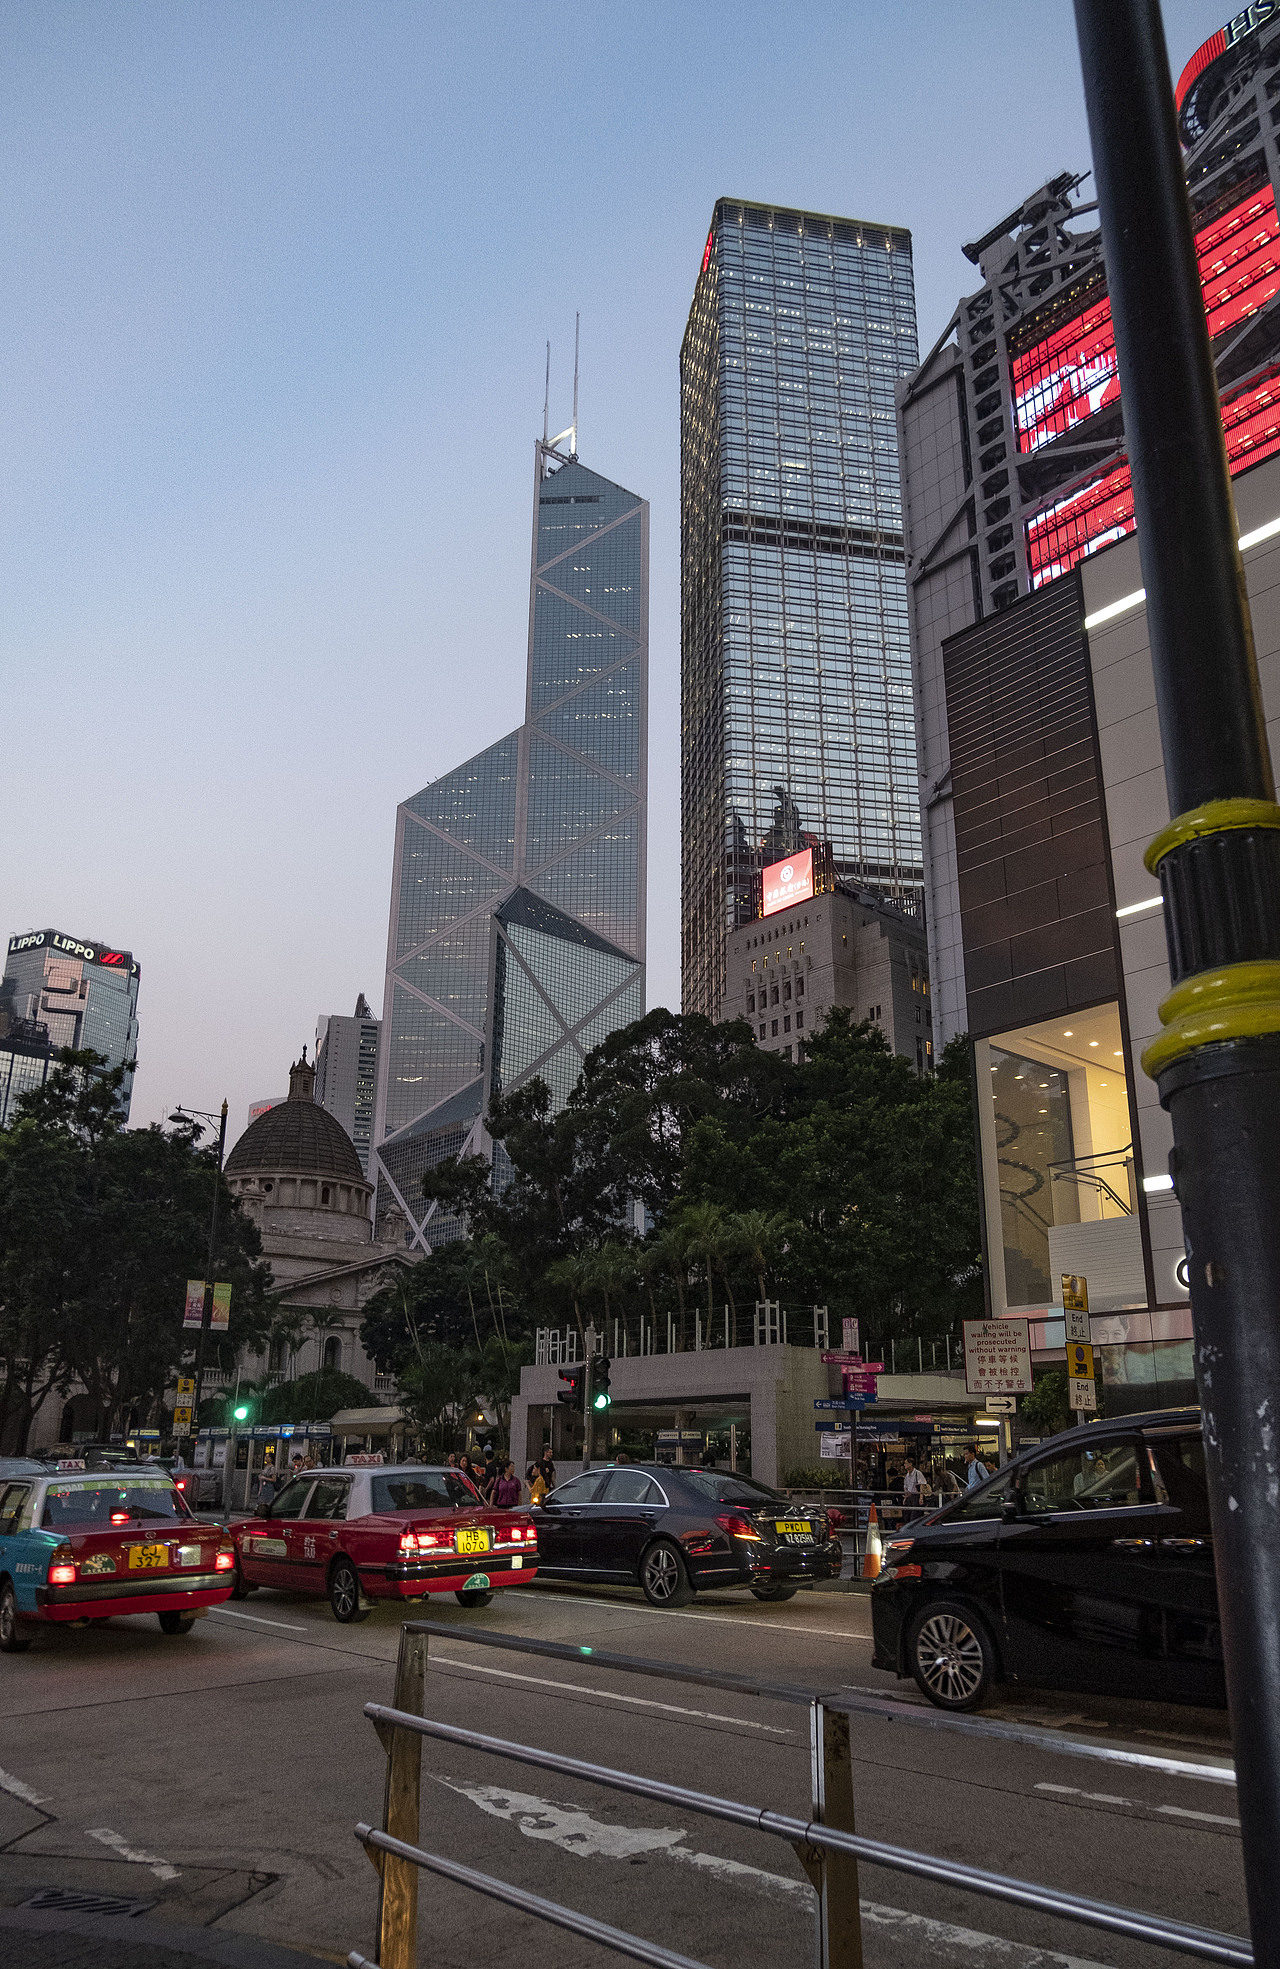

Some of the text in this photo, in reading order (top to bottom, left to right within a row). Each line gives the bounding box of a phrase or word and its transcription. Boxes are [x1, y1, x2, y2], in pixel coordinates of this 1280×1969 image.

[10, 933, 45, 951] LIPPO
[53, 934, 95, 960] LIPPO
[1071, 1313, 1083, 1323] End
[970, 1331, 996, 1339] waiting
[977, 1338, 1017, 1347] prosecuted
[998, 1346, 1027, 1354] warning
[977, 1354, 1019, 1365] 停車等候
[978, 1367, 1020, 1377] 會被檢控
[973, 1379, 1026, 1389] 而不予警告
[1076, 1382, 1089, 1392] End
[351, 1454, 381, 1464] TAXI
[465, 1531, 480, 1541] HB
[141, 1545, 158, 1557] CJ
[462, 1541, 485, 1552] 1070
[135, 1555, 162, 1568] 327
